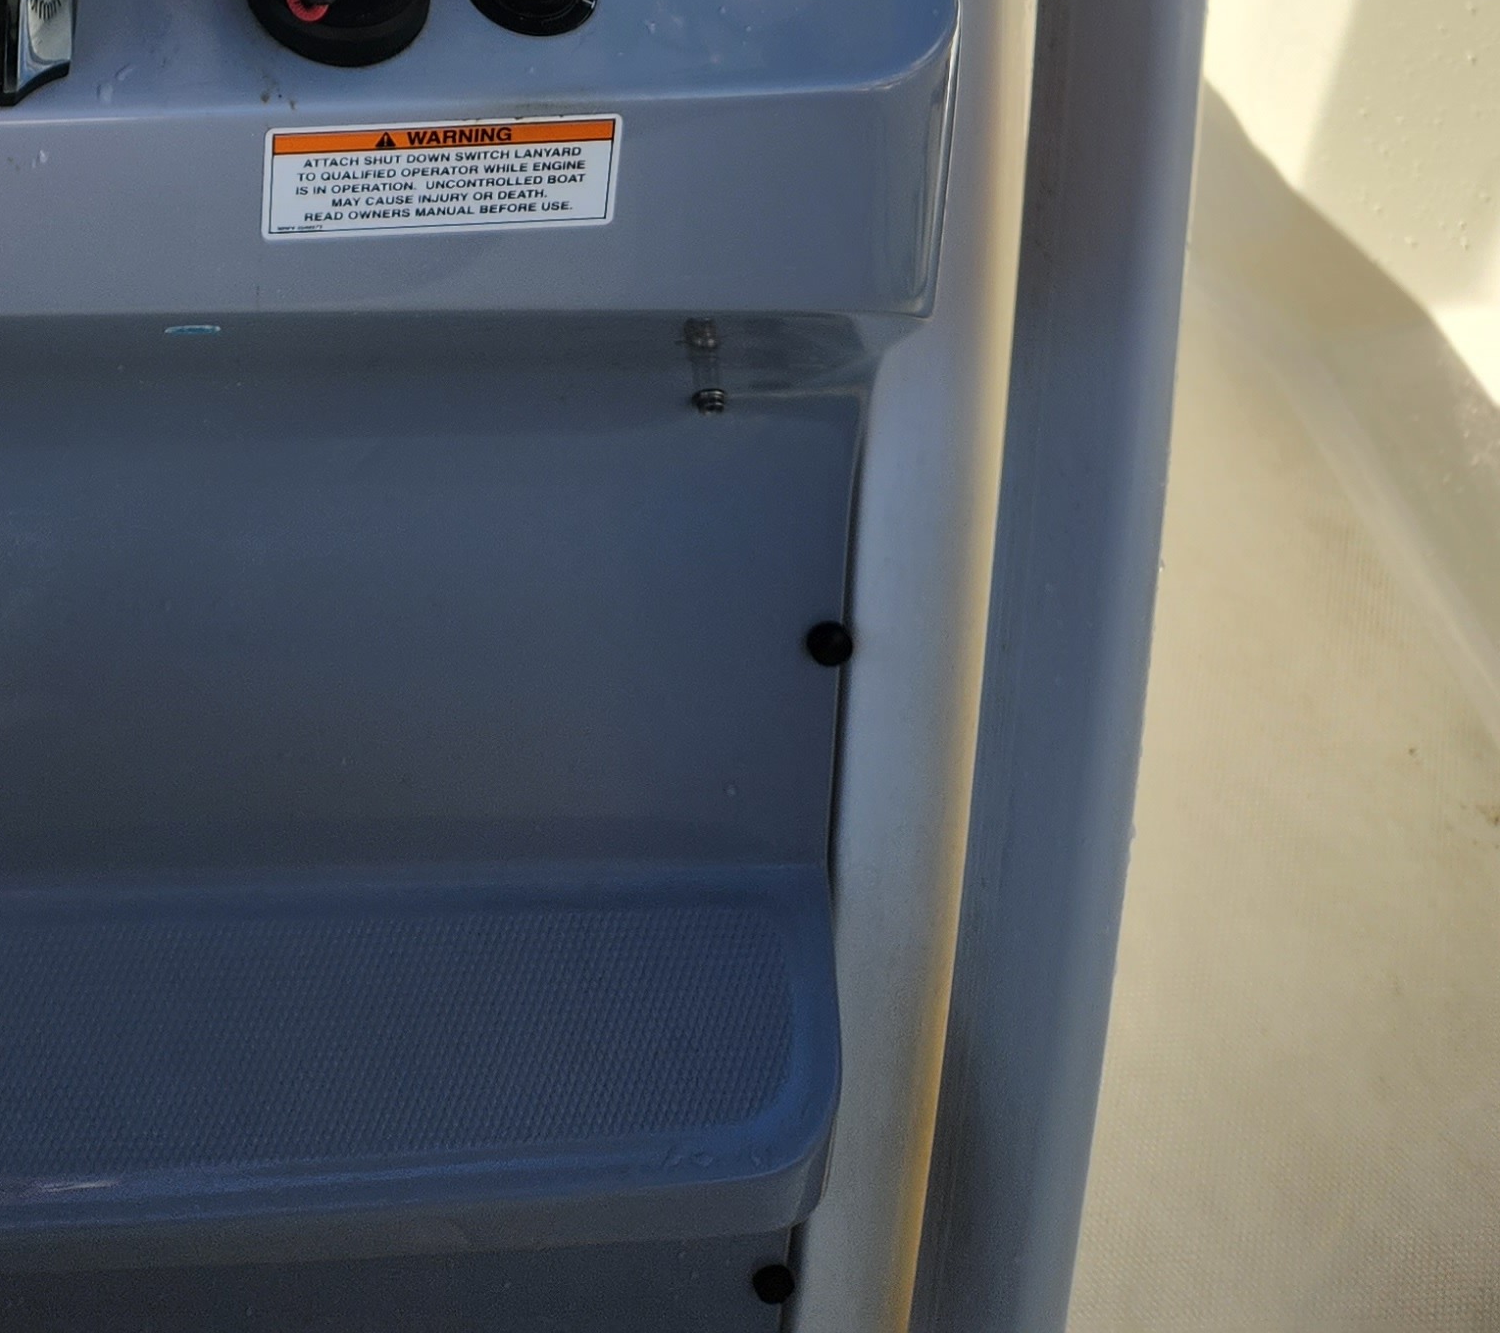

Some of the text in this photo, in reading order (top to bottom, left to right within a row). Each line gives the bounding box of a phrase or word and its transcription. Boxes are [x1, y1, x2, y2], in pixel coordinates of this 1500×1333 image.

[407, 126, 512, 146] WARNING
[303, 147, 582, 169] ATTACH SHUT DOWN SWITCH LANYARD
[297, 160, 586, 182] TO QUALIFIED OPERATOR WHILE ENGINE
[295, 173, 586, 196] IS IN OPERATION. UNCONTROLLED BOAT
[331, 188, 547, 208] MAY CAUSE INJURY OR DEATH.
[304, 200, 573, 222] READ OWNERS MANUAL BEFORE USE.
